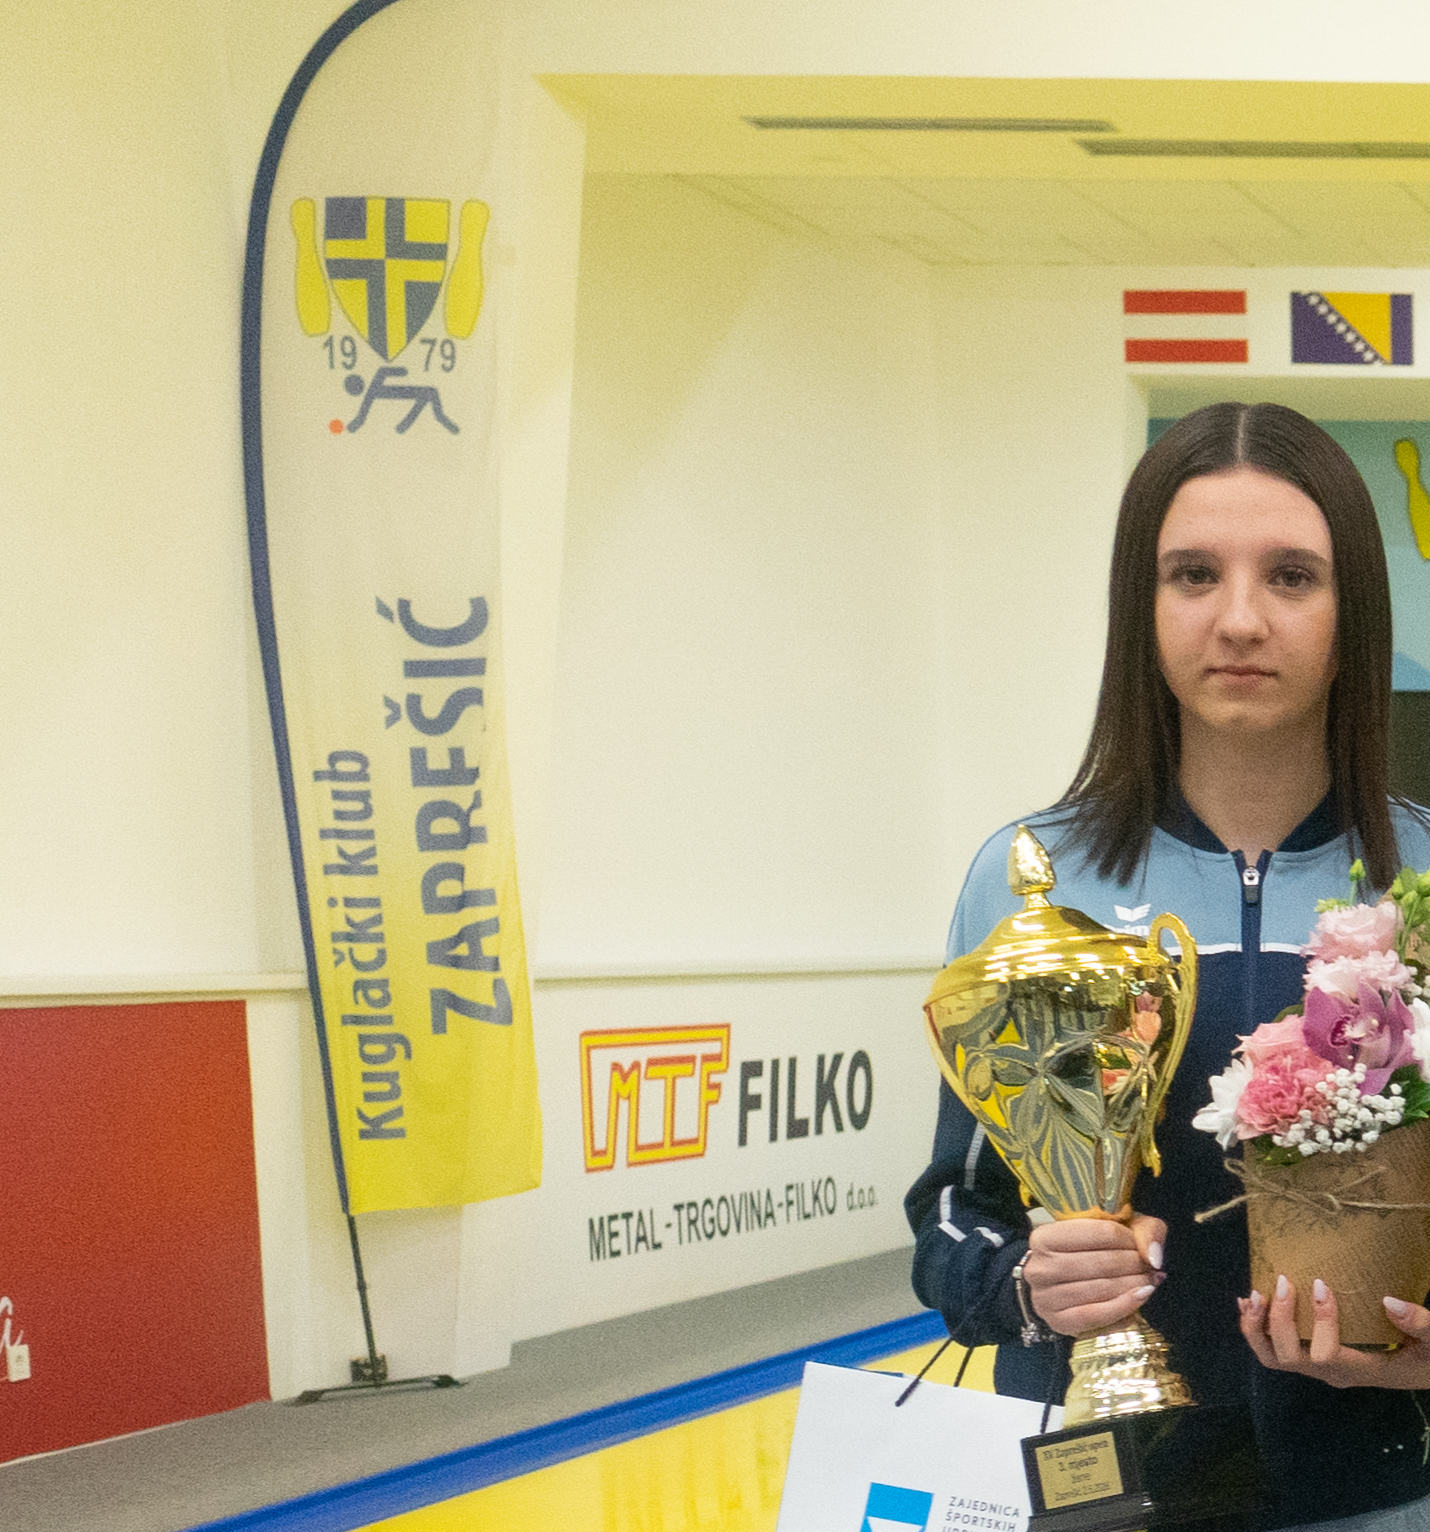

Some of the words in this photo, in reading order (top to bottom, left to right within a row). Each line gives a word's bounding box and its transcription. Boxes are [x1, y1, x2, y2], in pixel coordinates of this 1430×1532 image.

[323, 335, 357, 370] 19
[420, 338, 456, 373] 79
[313, 750, 379, 876] klub
[376, 596, 514, 1036] ZAPREŠIĆ
[330, 896, 412, 1140] Kuglački
[737, 1050, 873, 1147] FILKO
[945, 1509, 1016, 1532] ŠPORTSKIH
[948, 1496, 1020, 1518] ZAJEDNICA
